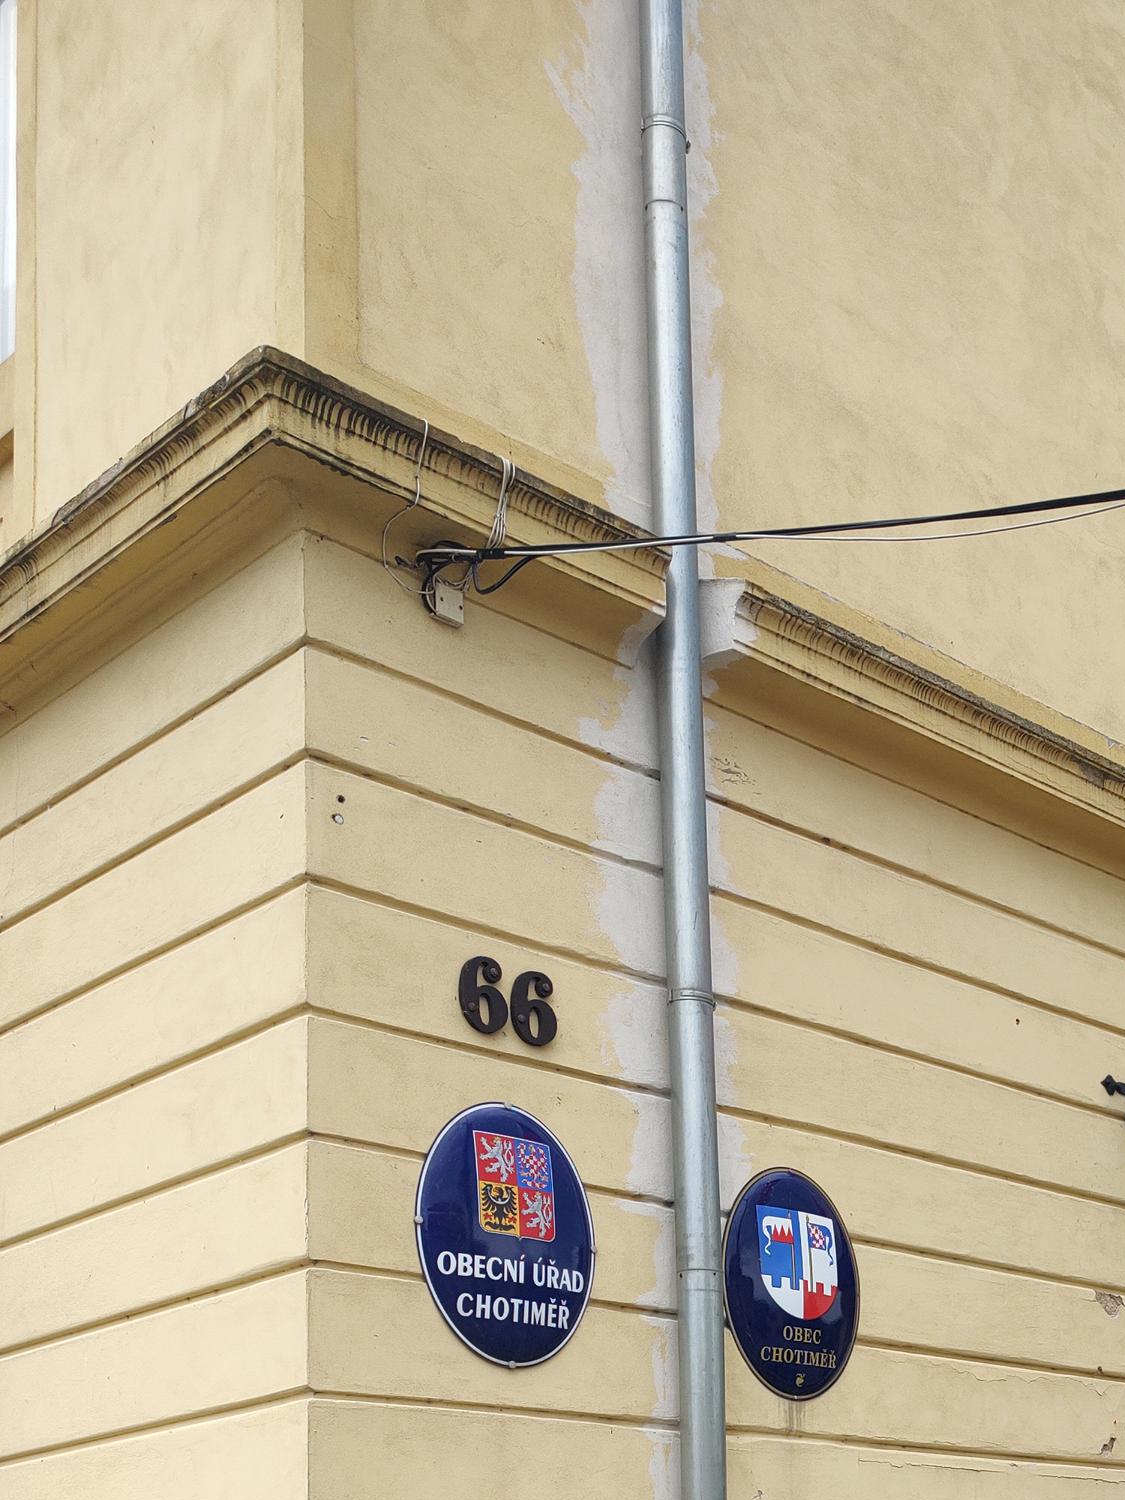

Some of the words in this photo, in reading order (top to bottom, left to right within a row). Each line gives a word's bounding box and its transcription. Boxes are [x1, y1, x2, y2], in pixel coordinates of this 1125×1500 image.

[458, 956, 558, 1047] 66
[436, 1250, 526, 1284] OBECNÍ
[532, 1256, 585, 1294] ÚŘAD
[456, 1292, 570, 1330] CHOTIMĚŘ
[782, 1325, 822, 1345] OBEC
[760, 1345, 837, 1369] CHOTIMĚŘ
